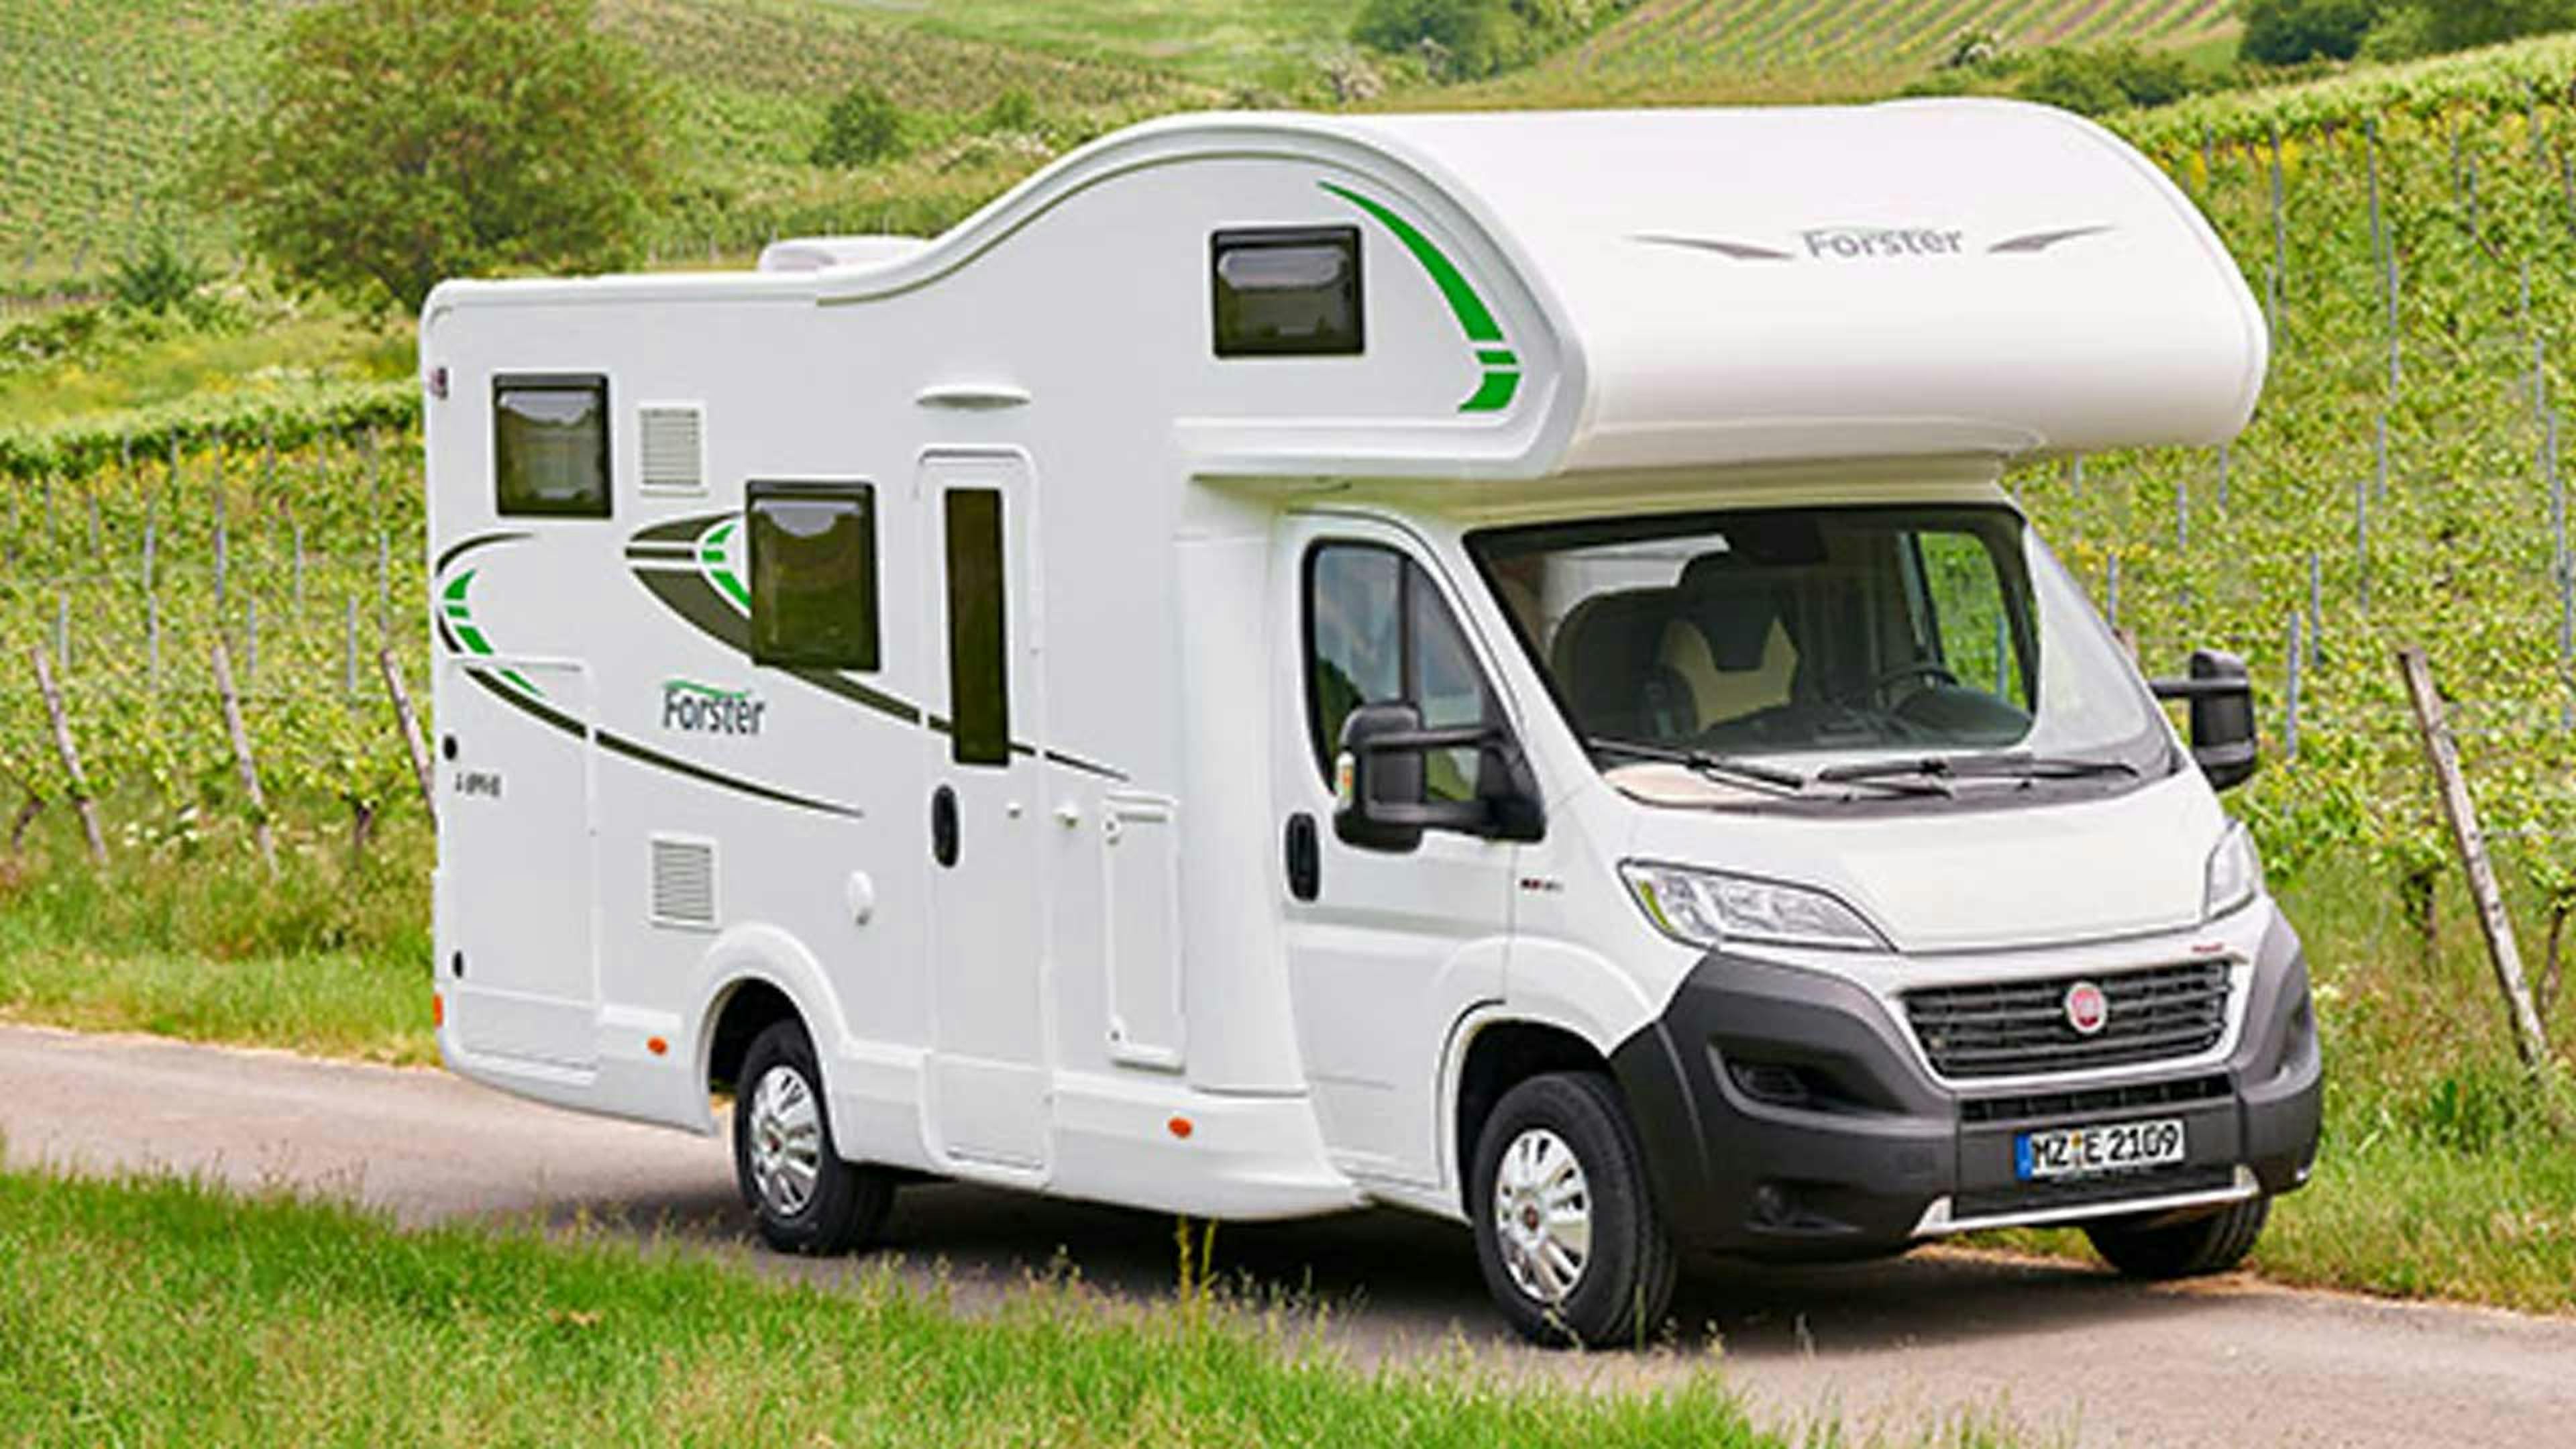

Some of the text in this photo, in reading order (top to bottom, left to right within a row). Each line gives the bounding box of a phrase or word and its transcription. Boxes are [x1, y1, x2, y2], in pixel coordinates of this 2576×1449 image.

[1803, 229, 1963, 258] Forster
[663, 684, 765, 735] Forster
[2032, 1124, 2178, 1168] MZ E 2109
